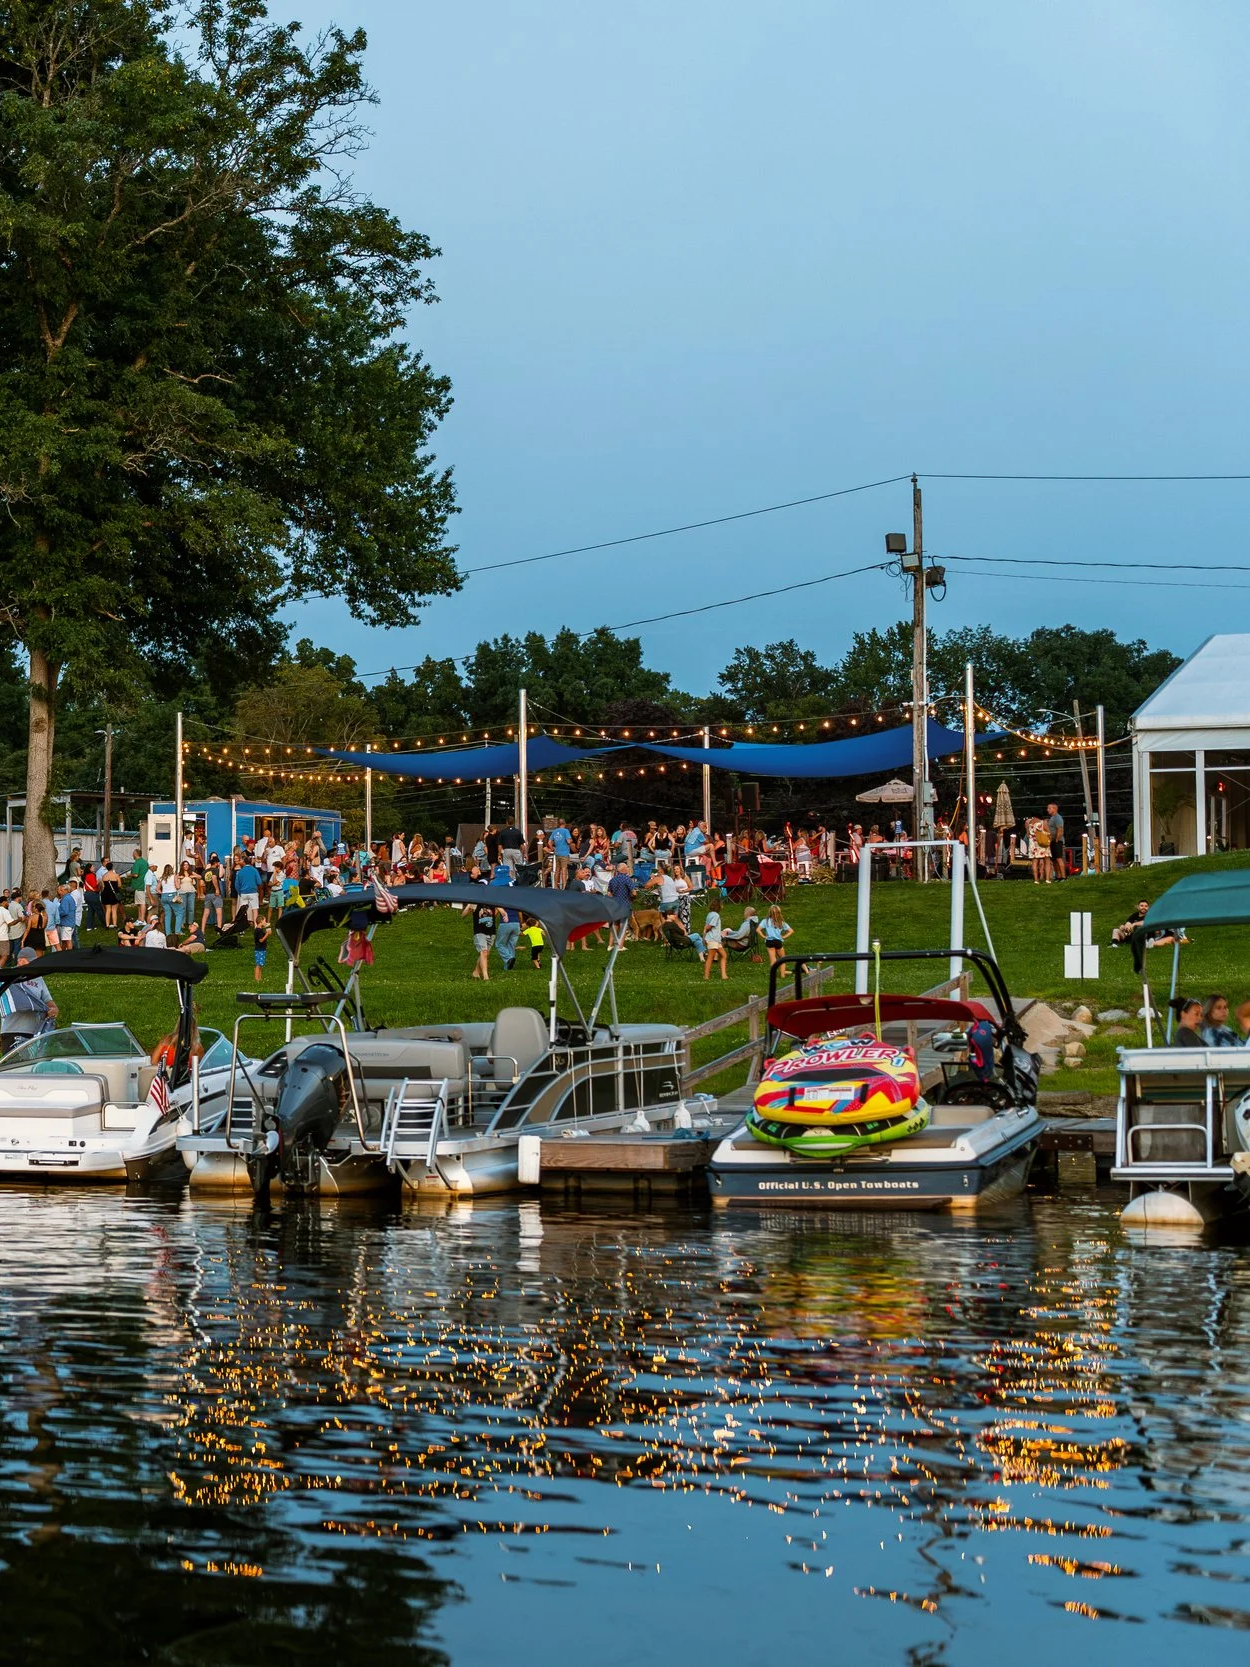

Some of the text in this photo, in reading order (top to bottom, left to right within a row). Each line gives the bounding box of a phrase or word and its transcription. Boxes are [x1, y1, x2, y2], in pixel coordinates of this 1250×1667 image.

[762, 1047, 900, 1080] PROWLER
[758, 1180, 919, 1191] Official U.S. Open Towboats
